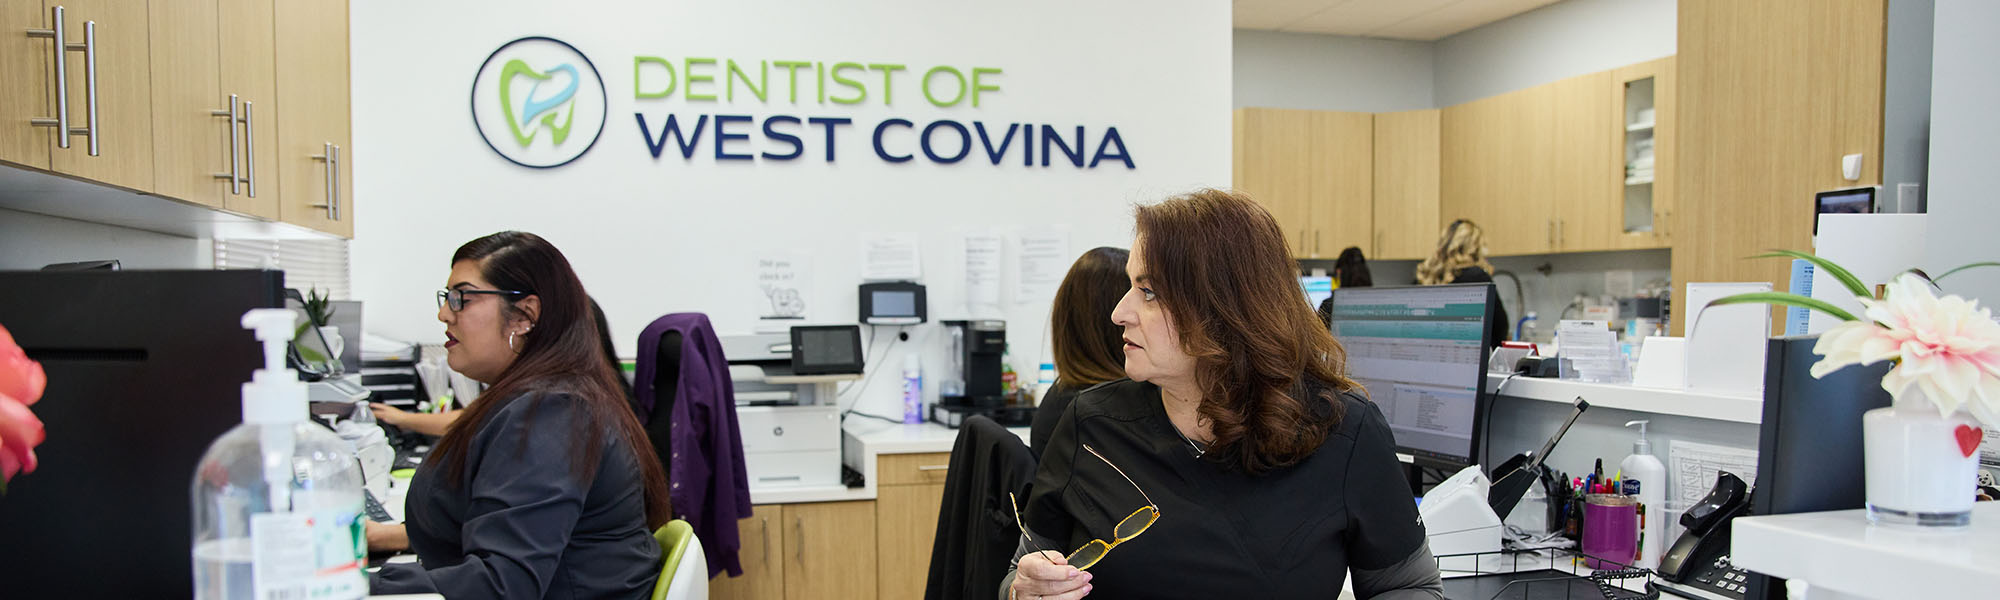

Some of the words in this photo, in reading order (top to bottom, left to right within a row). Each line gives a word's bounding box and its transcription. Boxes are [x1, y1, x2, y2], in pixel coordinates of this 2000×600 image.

[633, 55, 907, 106] DENTIST
[920, 64, 1003, 109] OF
[634, 112, 852, 163] WEST
[872, 118, 1136, 170] COVINA
